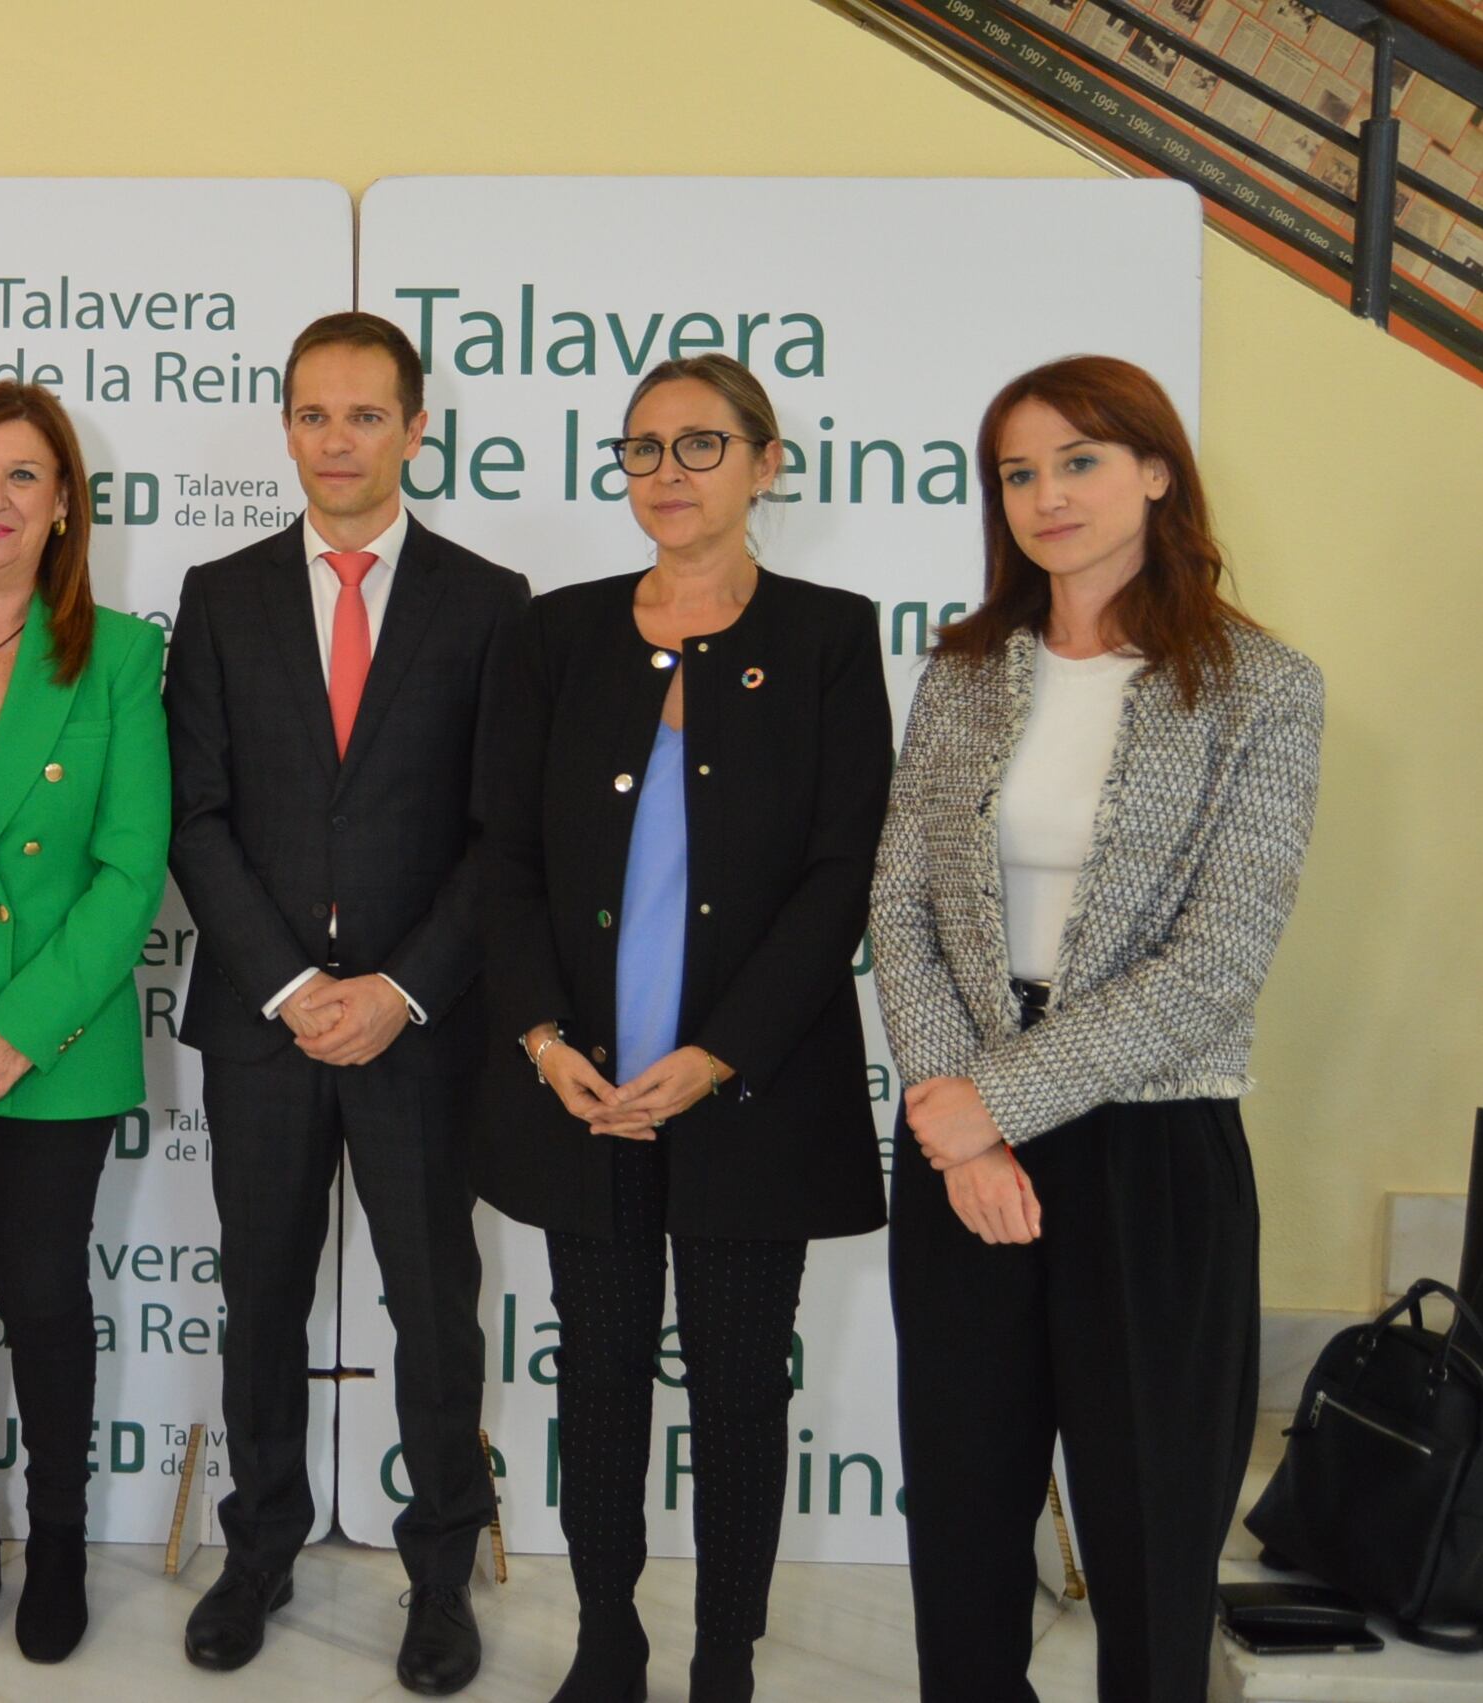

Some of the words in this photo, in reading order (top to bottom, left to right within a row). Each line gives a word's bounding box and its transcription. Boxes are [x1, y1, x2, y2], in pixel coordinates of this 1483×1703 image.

[982, 20, 1011, 46] 1998
[1018, 44, 1047, 68] 1997
[1054, 67, 1084, 93] 1996
[1090, 91, 1120, 116] 1995
[1126, 113, 1156, 139] 1994
[1162, 137, 1191, 162] 1993
[1198, 160, 1226, 185] 1992
[1233, 183, 1261, 208] 1991
[395, 284, 825, 378] Talavera
[86, 348, 130, 402] la
[154, 352, 282, 404] Rein
[400, 409, 525, 501] de
[766, 416, 967, 505] eina
[89, 472, 159, 525] ED
[174, 474, 279, 497] Talavera
[174, 504, 206, 527] de
[215, 504, 235, 527] la
[244, 505, 300, 528] Rein
[165, 1139, 197, 1161] de
[95, 1243, 221, 1284] vera
[141, 1303, 226, 1355] Rei
